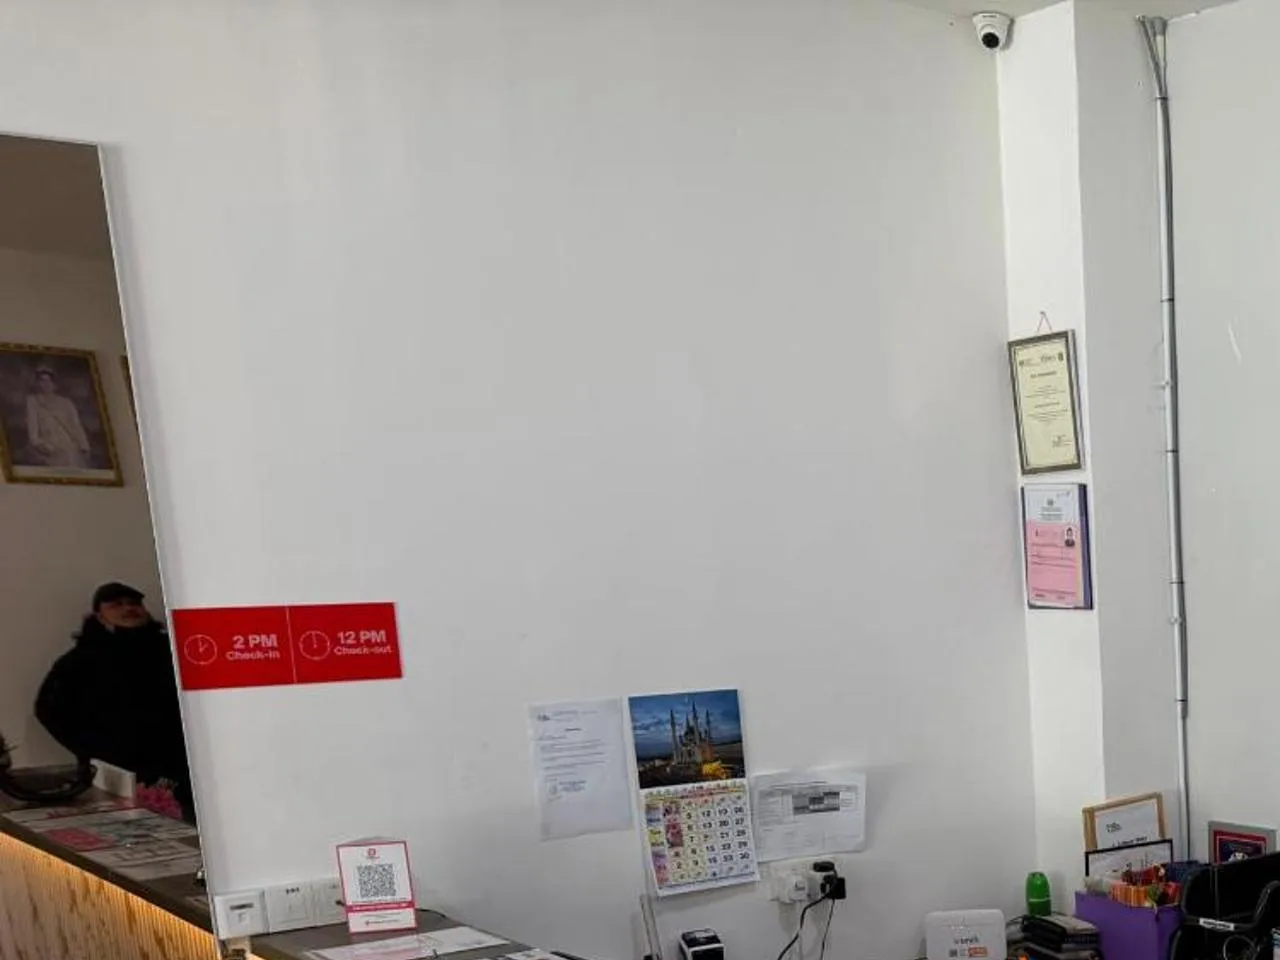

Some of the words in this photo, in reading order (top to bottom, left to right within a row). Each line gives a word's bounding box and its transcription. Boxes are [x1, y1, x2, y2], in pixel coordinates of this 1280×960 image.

[232, 634, 245, 648] 2
[249, 634, 278, 648] PM
[338, 631, 357, 644] 12
[360, 630, 387, 643] PM
